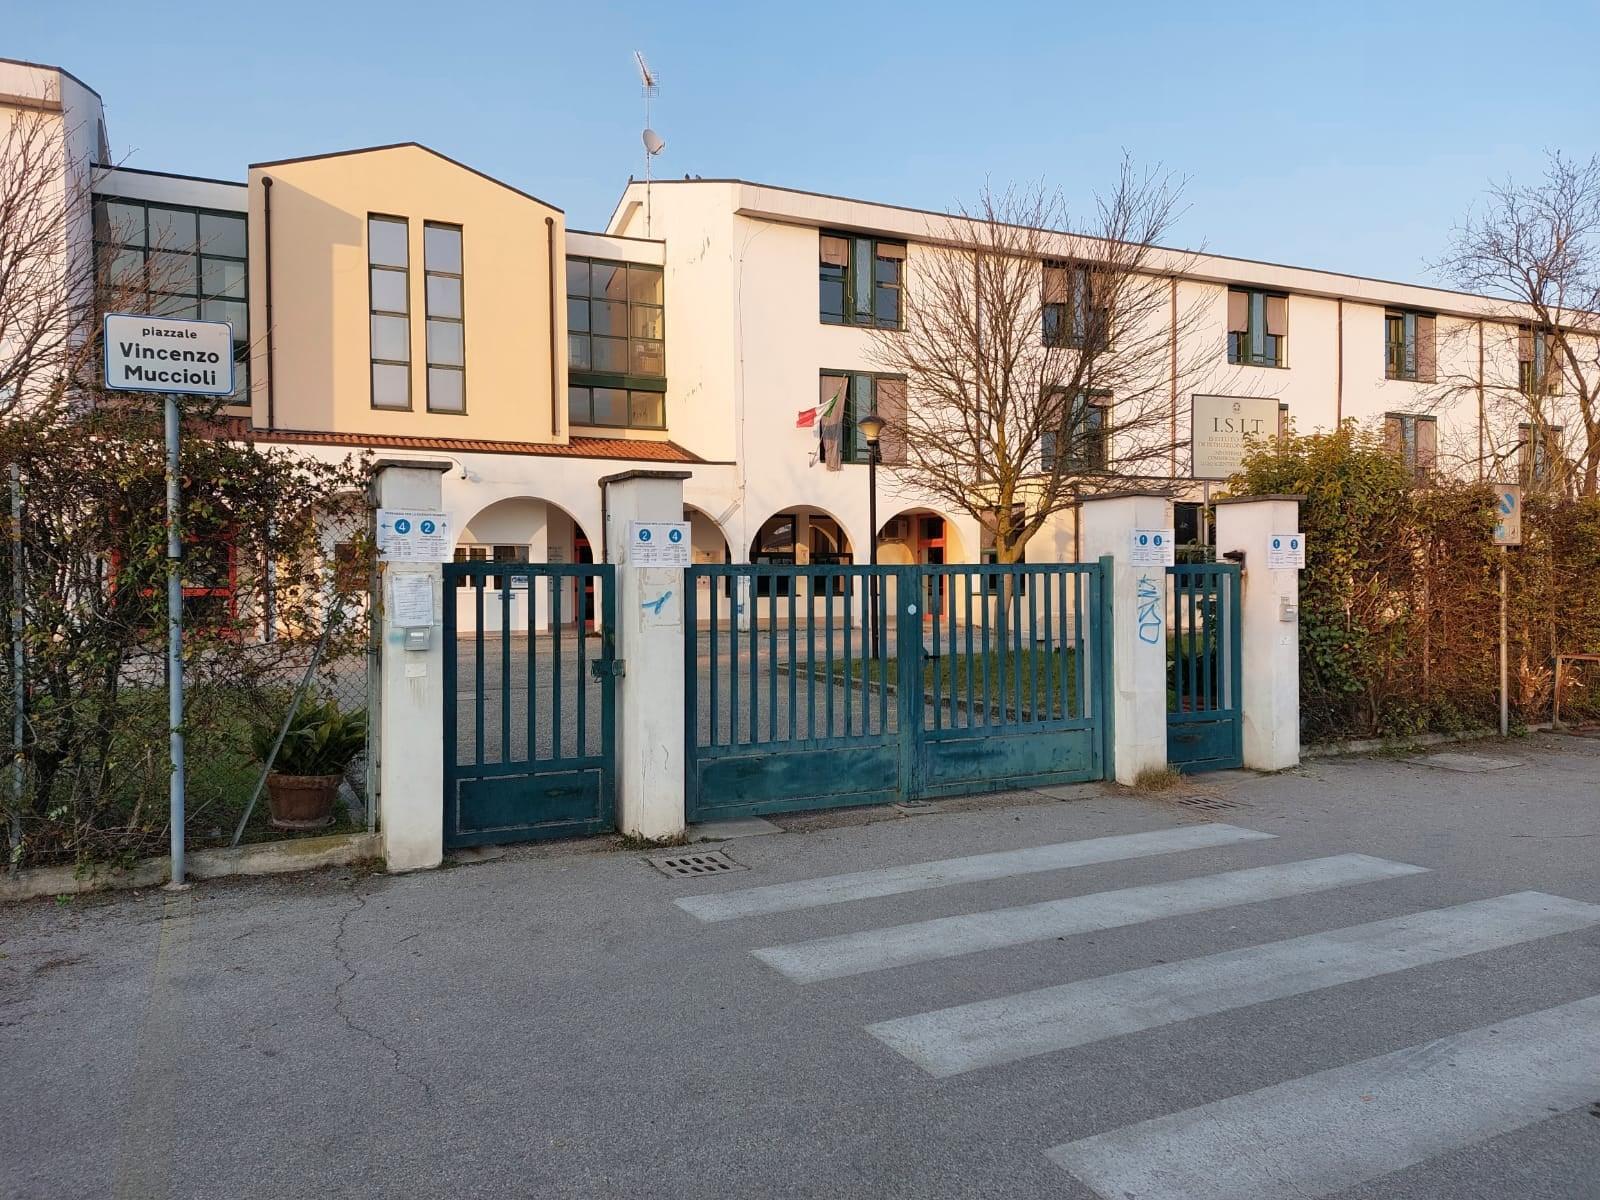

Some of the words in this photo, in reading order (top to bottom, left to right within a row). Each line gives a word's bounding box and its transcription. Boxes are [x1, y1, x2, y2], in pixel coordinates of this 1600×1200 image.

[142, 327, 198, 339] piazzale
[120, 342, 220, 364] Vincenzo
[124, 365, 216, 386] Muccioli
